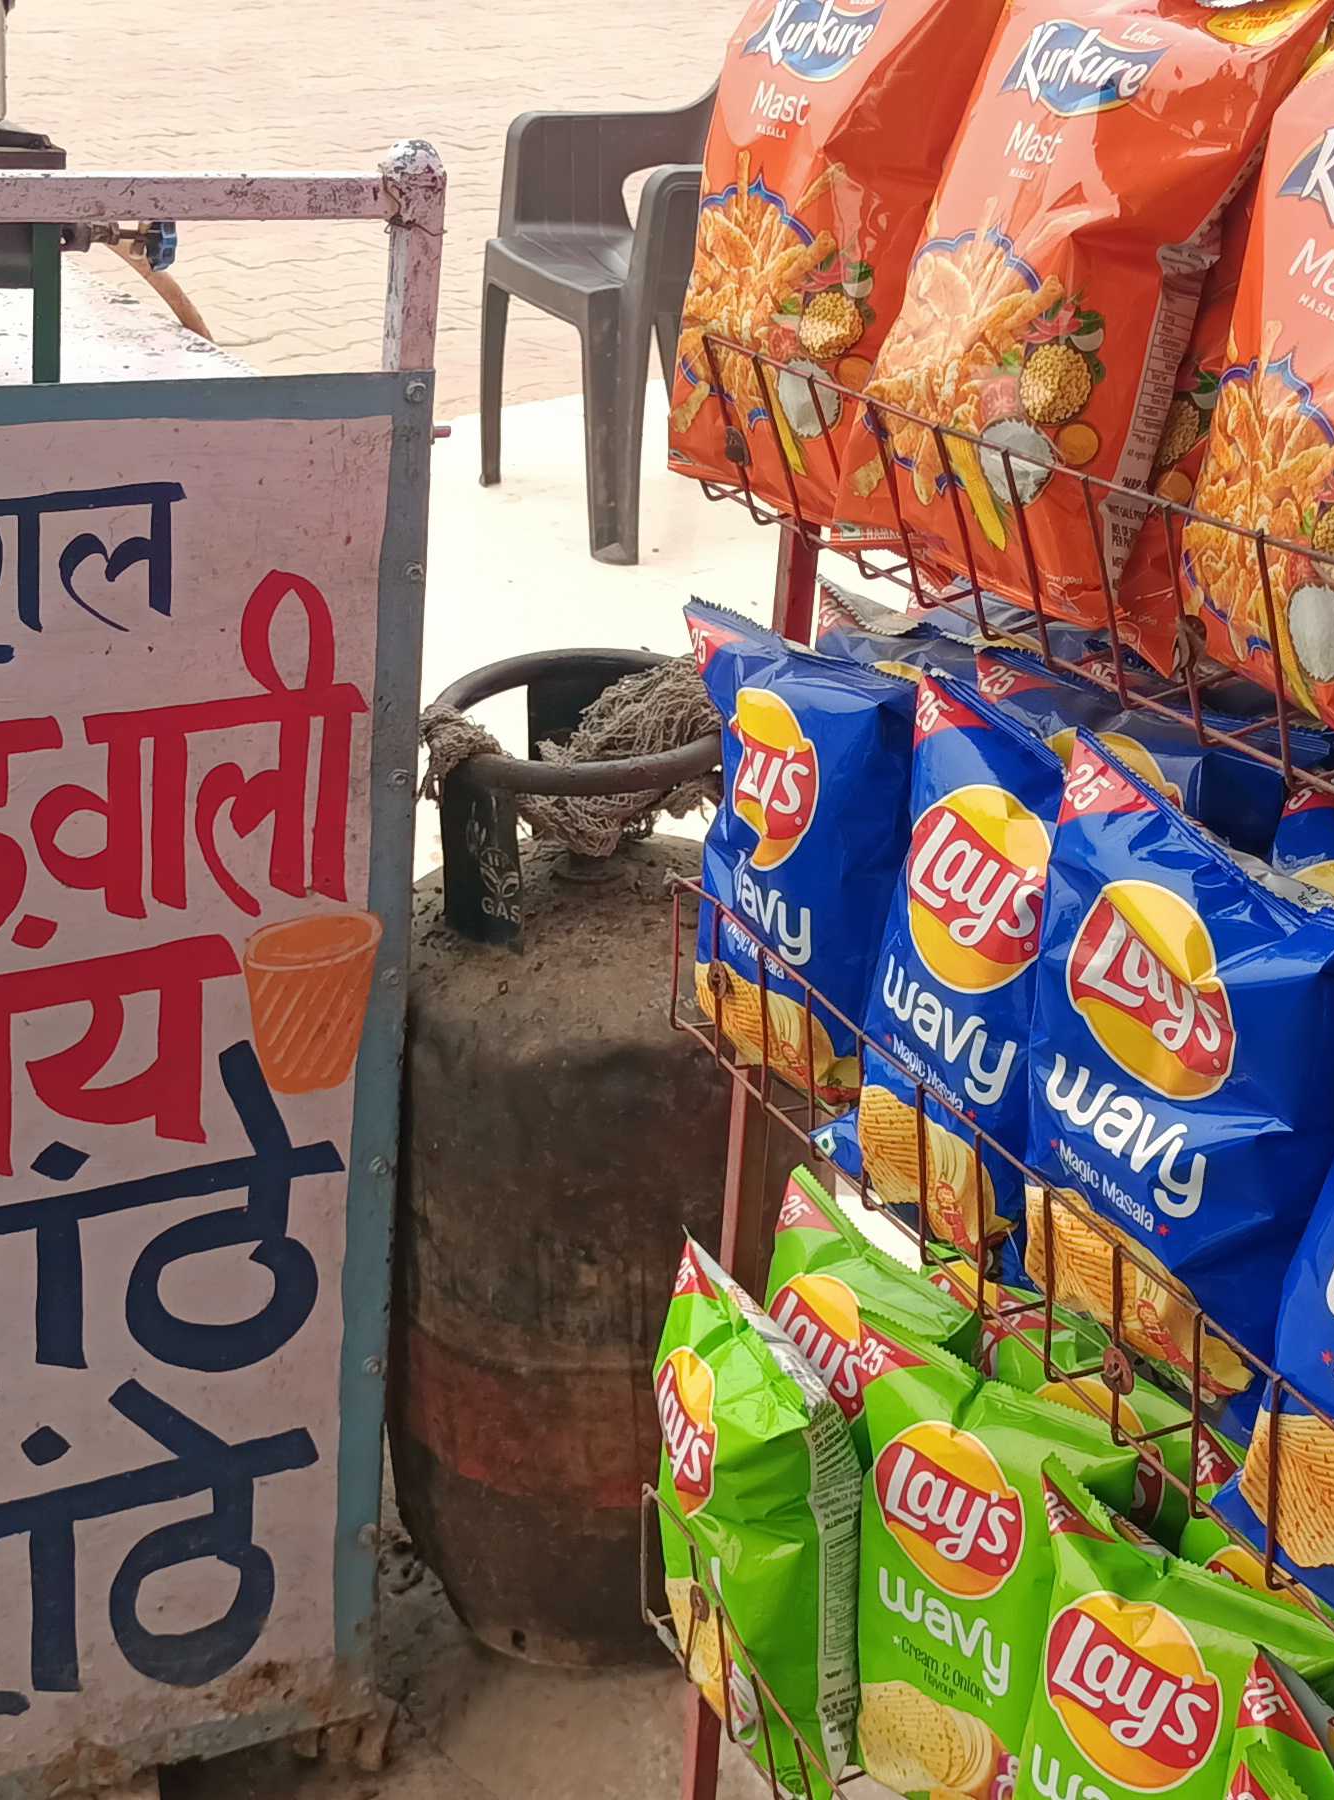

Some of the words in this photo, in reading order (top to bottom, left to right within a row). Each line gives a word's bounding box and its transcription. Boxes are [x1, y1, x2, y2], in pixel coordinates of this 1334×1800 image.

[756, 0, 874, 66] Kurkure
[1015, 23, 1148, 105] Kurkure
[751, 80, 810, 126] Mast
[755, 124, 787, 139] MASALA
[1004, 120, 1063, 164] Mast
[916, 689, 947, 734] 25
[1065, 763, 1105, 811] 25
[481, 897, 522, 924] GAS
[910, 811, 1044, 947] Lay's
[1078, 913, 1221, 1052] Lay's
[883, 954, 1017, 1106] wavy
[1046, 1053, 1207, 1219] wavy
[1059, 1138, 1099, 1189] Magic
[1102, 1178, 1155, 1233] Masala
[861, 1337, 891, 1376] 25
[657, 1362, 710, 1484] Lay's
[885, 1446, 1016, 1562] Lay's
[879, 1566, 1010, 1697] wavy
[901, 1636, 939, 1676] Cream
[952, 1668, 985, 1703] Onion
[1051, 1613, 1211, 1748] Lay's
[1241, 1677, 1281, 1721] 25
